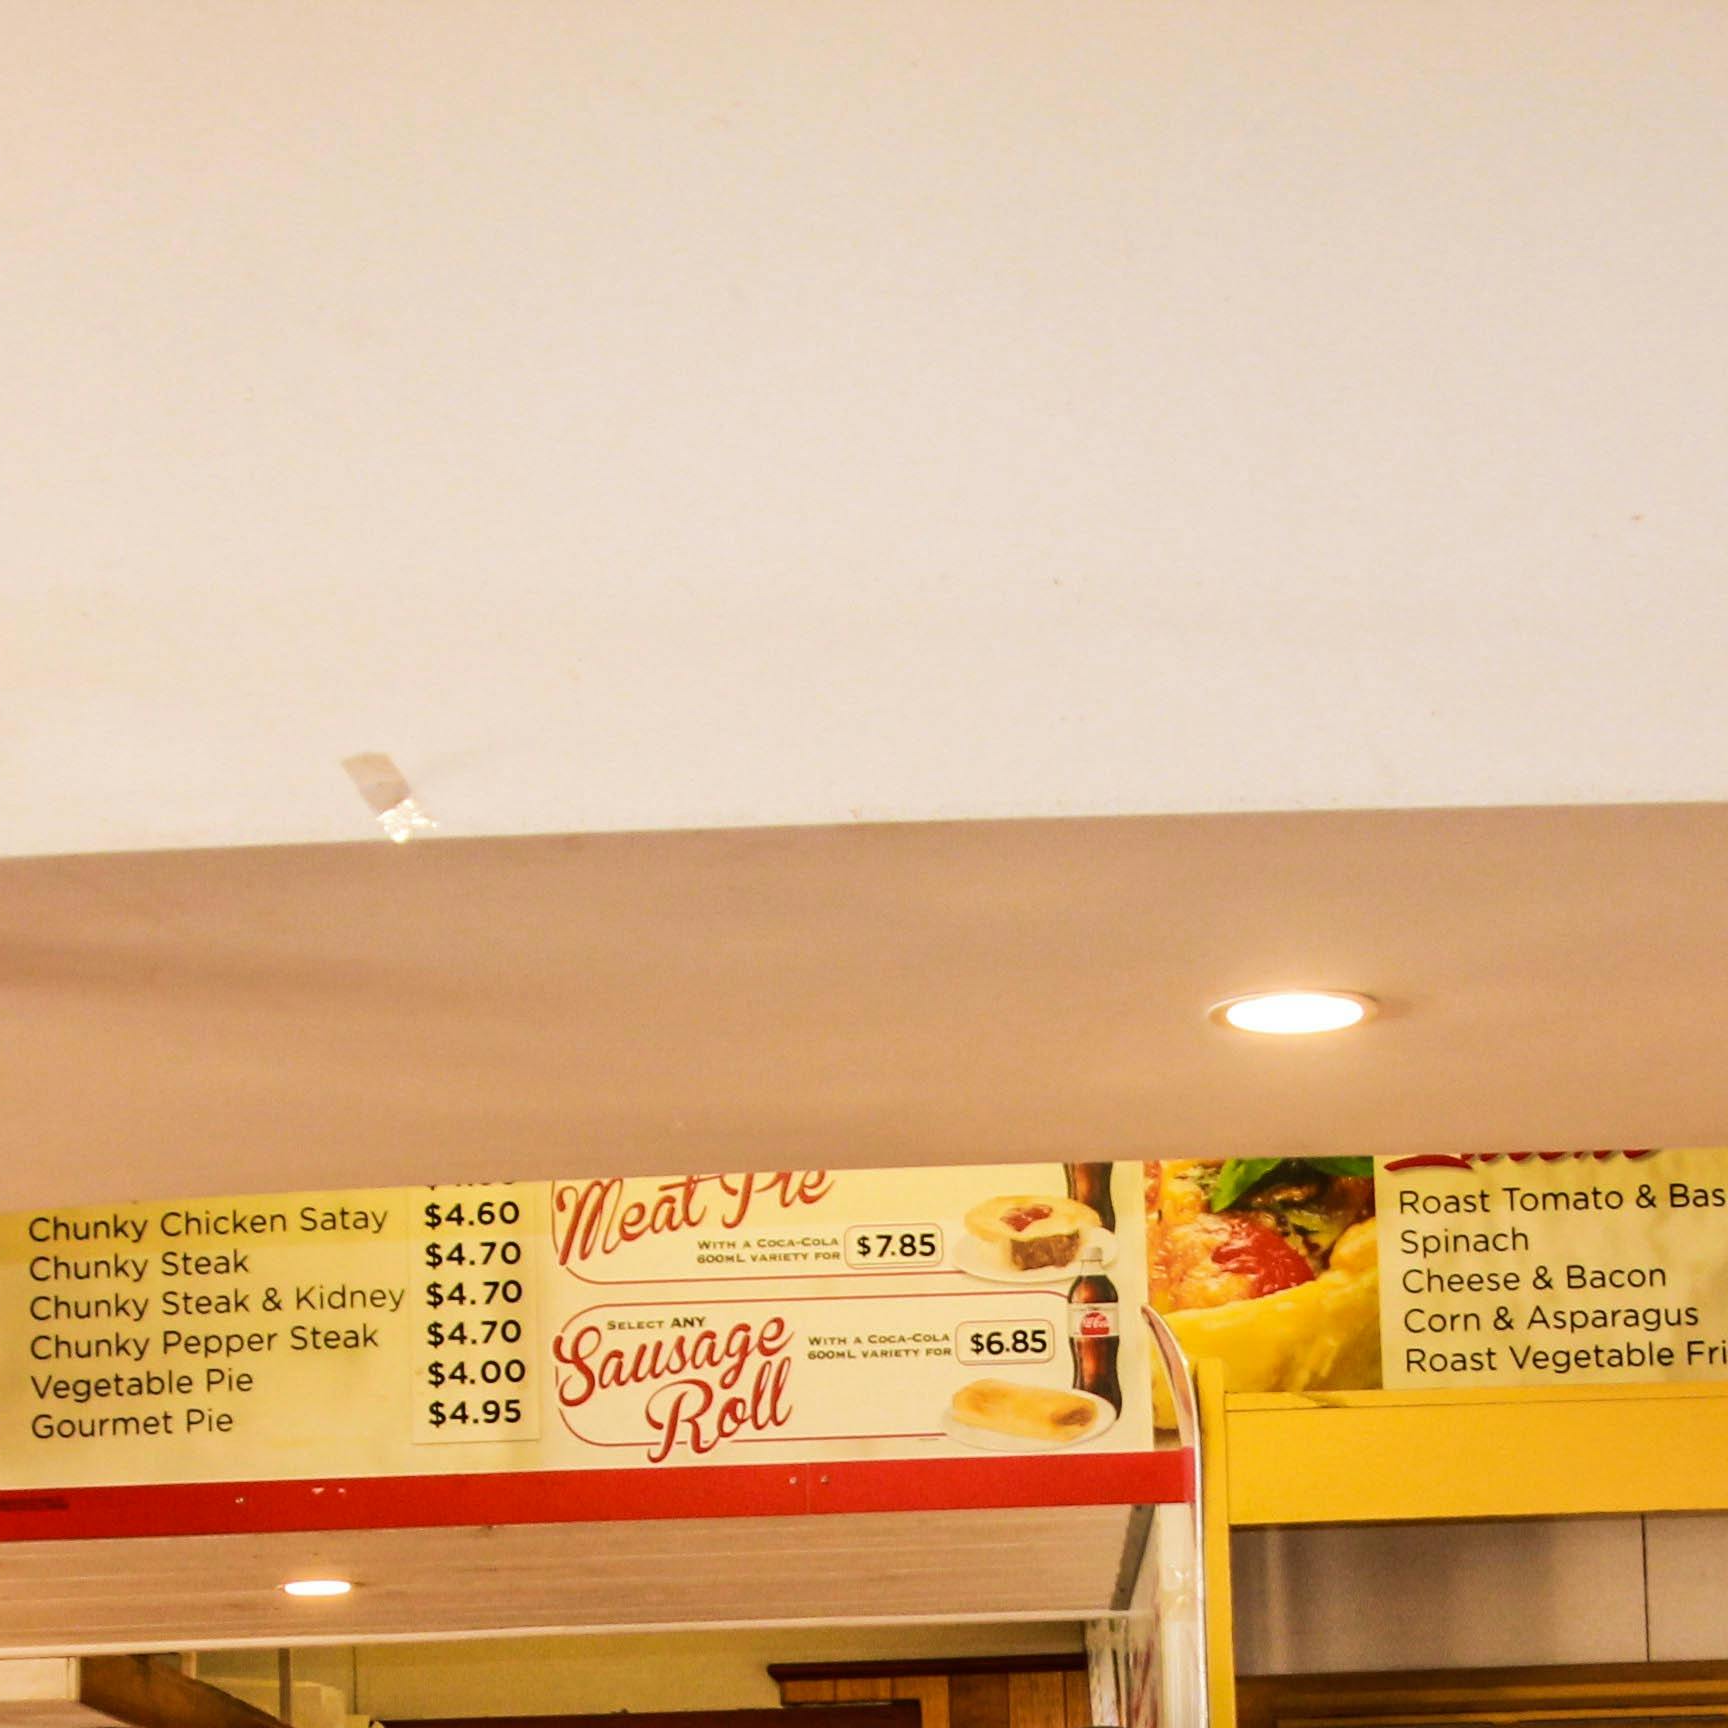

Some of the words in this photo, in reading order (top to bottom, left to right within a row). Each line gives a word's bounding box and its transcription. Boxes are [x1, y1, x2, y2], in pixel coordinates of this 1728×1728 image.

[1399, 1188, 1490, 1216] Roast
[1503, 1184, 1624, 1213] Tomato
[1635, 1183, 1657, 1210] &
[28, 1215, 148, 1243] Chunky
[160, 1209, 287, 1239] Chicken
[299, 1204, 389, 1233] Satay
[424, 1201, 520, 1229] $4.60
[556, 1177, 721, 1266] Meat
[750, 1252, 810, 1262] VARIETY
[814, 1250, 841, 1261] FOR
[856, 1233, 936, 1258] $7.85
[1400, 1227, 1529, 1260] Spinach
[29, 1254, 148, 1283] Chunky
[161, 1249, 249, 1278] Steak
[425, 1240, 521, 1269] $4.70
[1402, 1266, 1520, 1295] Cheese
[1531, 1266, 1554, 1291] &
[1566, 1263, 1667, 1290] Bacon
[29, 1294, 150, 1322] Chunky
[162, 1289, 249, 1317] Steak
[261, 1287, 283, 1313] &
[296, 1283, 406, 1312] Kidney
[425, 1279, 523, 1307] $4.70
[1404, 1306, 1481, 1335] Corn
[1492, 1306, 1514, 1332] &
[1528, 1301, 1699, 1333] Asparagus
[670, 1316, 707, 1329] ANY
[30, 1334, 150, 1362] Chunky
[163, 1328, 278, 1360] Pepper
[290, 1323, 379, 1350] Steak
[426, 1319, 522, 1347] $4.70
[860, 1349, 920, 1359] VARIETY
[925, 1347, 953, 1357] FOR
[970, 1329, 1048, 1356] $6.85
[1405, 1344, 1497, 1374] Roast
[1508, 1339, 1675, 1374] Vegetable
[553, 1317, 794, 1408] Sausage
[30, 1370, 193, 1404] Vegetable
[205, 1369, 254, 1394] Pie
[428, 1359, 526, 1388] $4.00
[31, 1412, 173, 1441] Gourmet
[186, 1409, 234, 1433] Pie
[428, 1399, 521, 1428] $4.95
[646, 1357, 793, 1464] Roll
